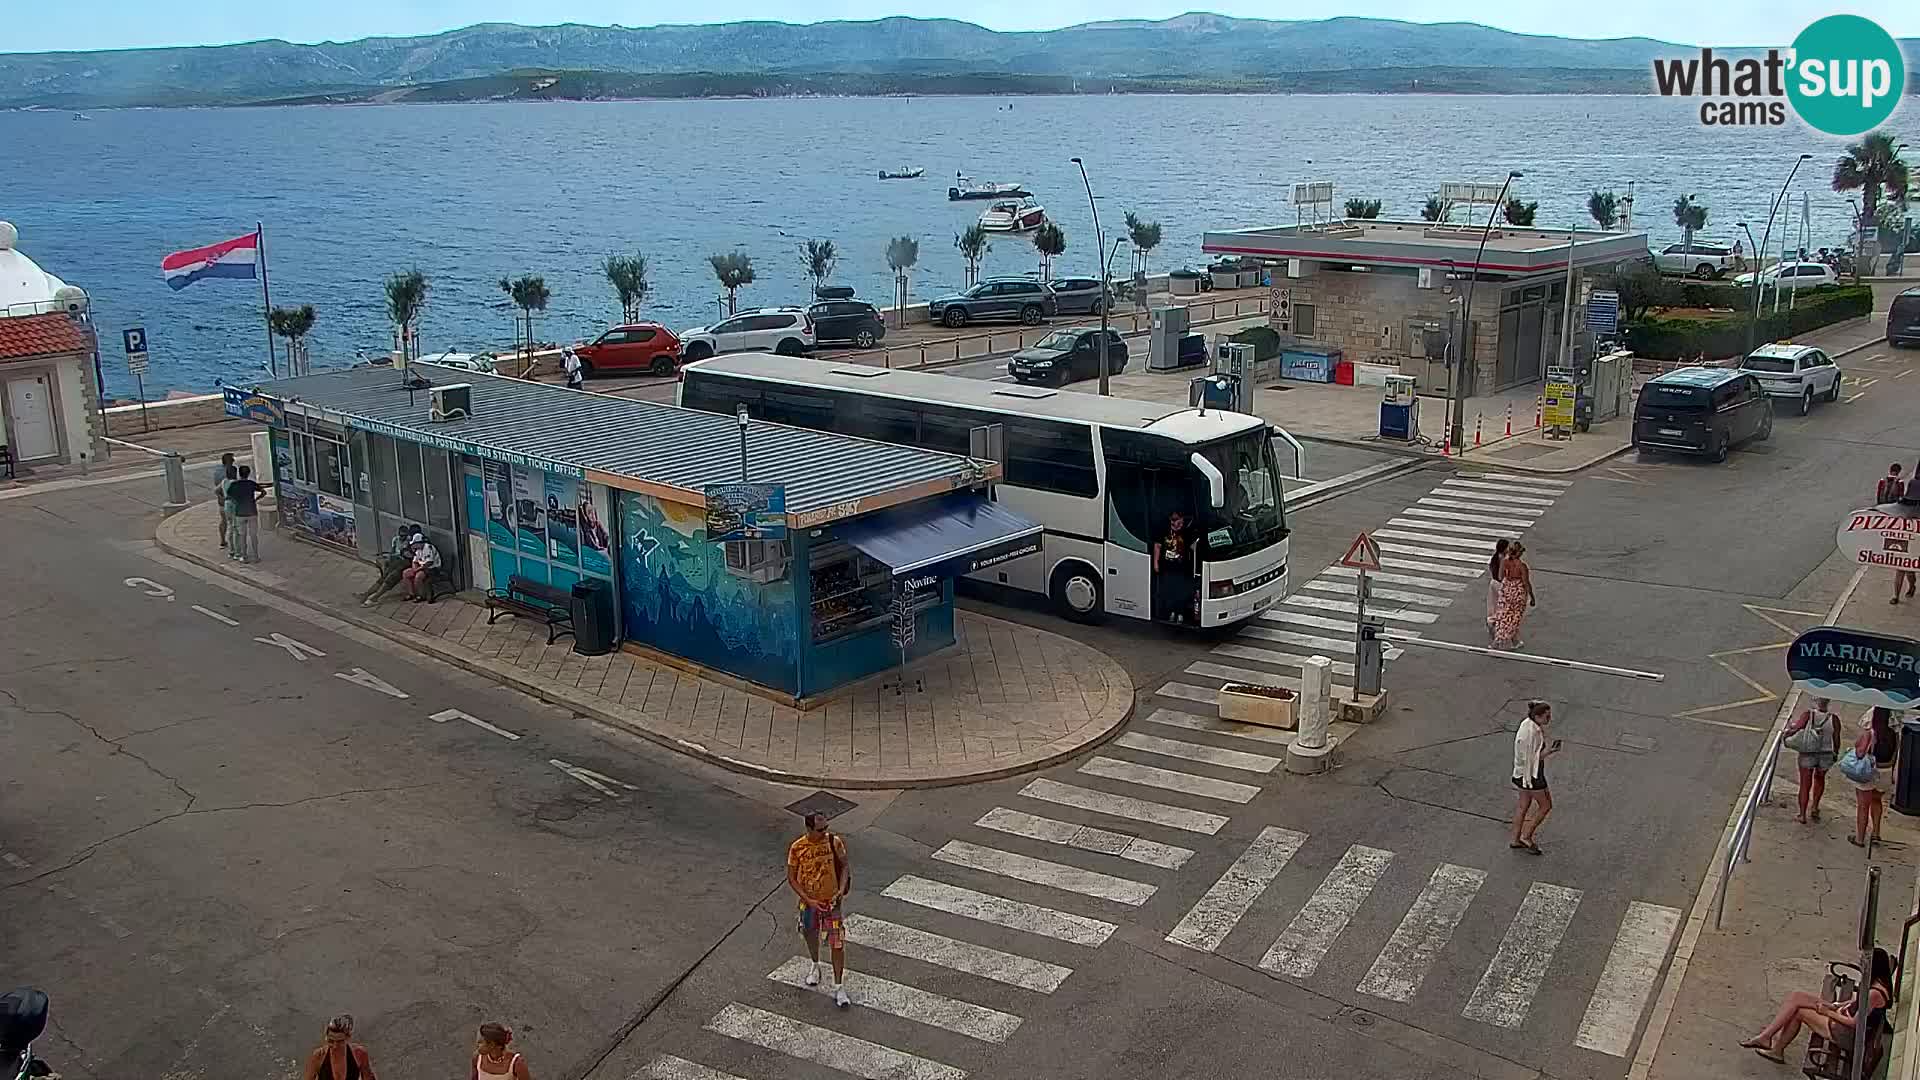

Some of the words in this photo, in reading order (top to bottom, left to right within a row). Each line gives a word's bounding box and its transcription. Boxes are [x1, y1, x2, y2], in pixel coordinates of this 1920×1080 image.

[128, 331, 141, 350] P
[394, 428, 434, 445] AUTOBUSNA
[435, 437, 466, 452] POSTAJA
[477, 446, 492, 458] BUS
[493, 450, 525, 465] STATION
[527, 458, 552, 471] TICKET
[554, 464, 581, 477] OFFICE
[1881, 531, 1916, 541] GRILL
[904, 575, 937, 592] Novine
[1828, 661, 1864, 676] caffe
[1869, 665, 1896, 681] bar
